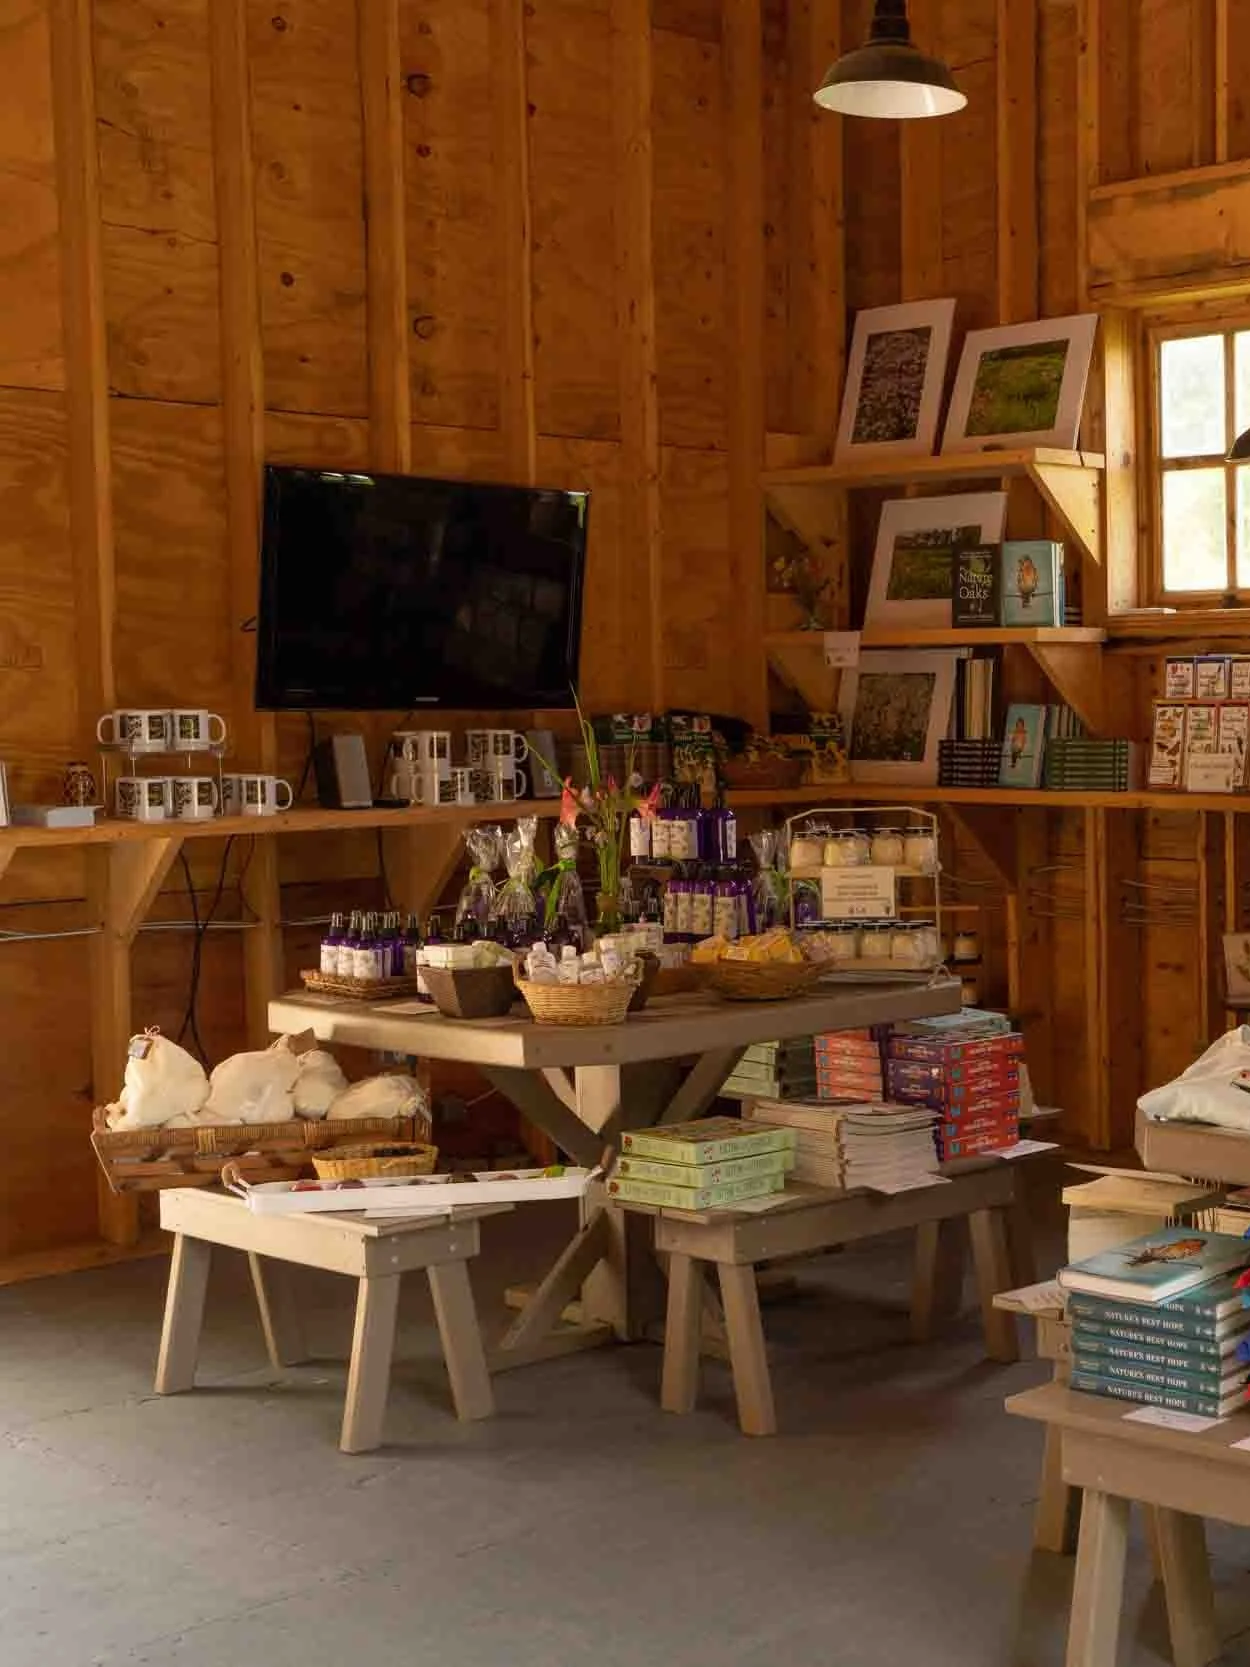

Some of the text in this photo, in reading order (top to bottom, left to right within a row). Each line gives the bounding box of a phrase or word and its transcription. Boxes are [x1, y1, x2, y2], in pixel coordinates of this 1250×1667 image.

[960, 584, 989, 600] Oaks
[1142, 1316, 1161, 1326] BEST
[1162, 1320, 1184, 1331] HOPE
[1146, 1335, 1166, 1346] BEST
[1167, 1339, 1188, 1350] HOPE
[1146, 1353, 1166, 1363] BEST
[1167, 1358, 1189, 1368] HOPE
[1146, 1373, 1166, 1384] BEST
[1167, 1378, 1188, 1388] HOPE
[1145, 1393, 1164, 1404] BEST
[1166, 1398, 1187, 1409] HOPE
